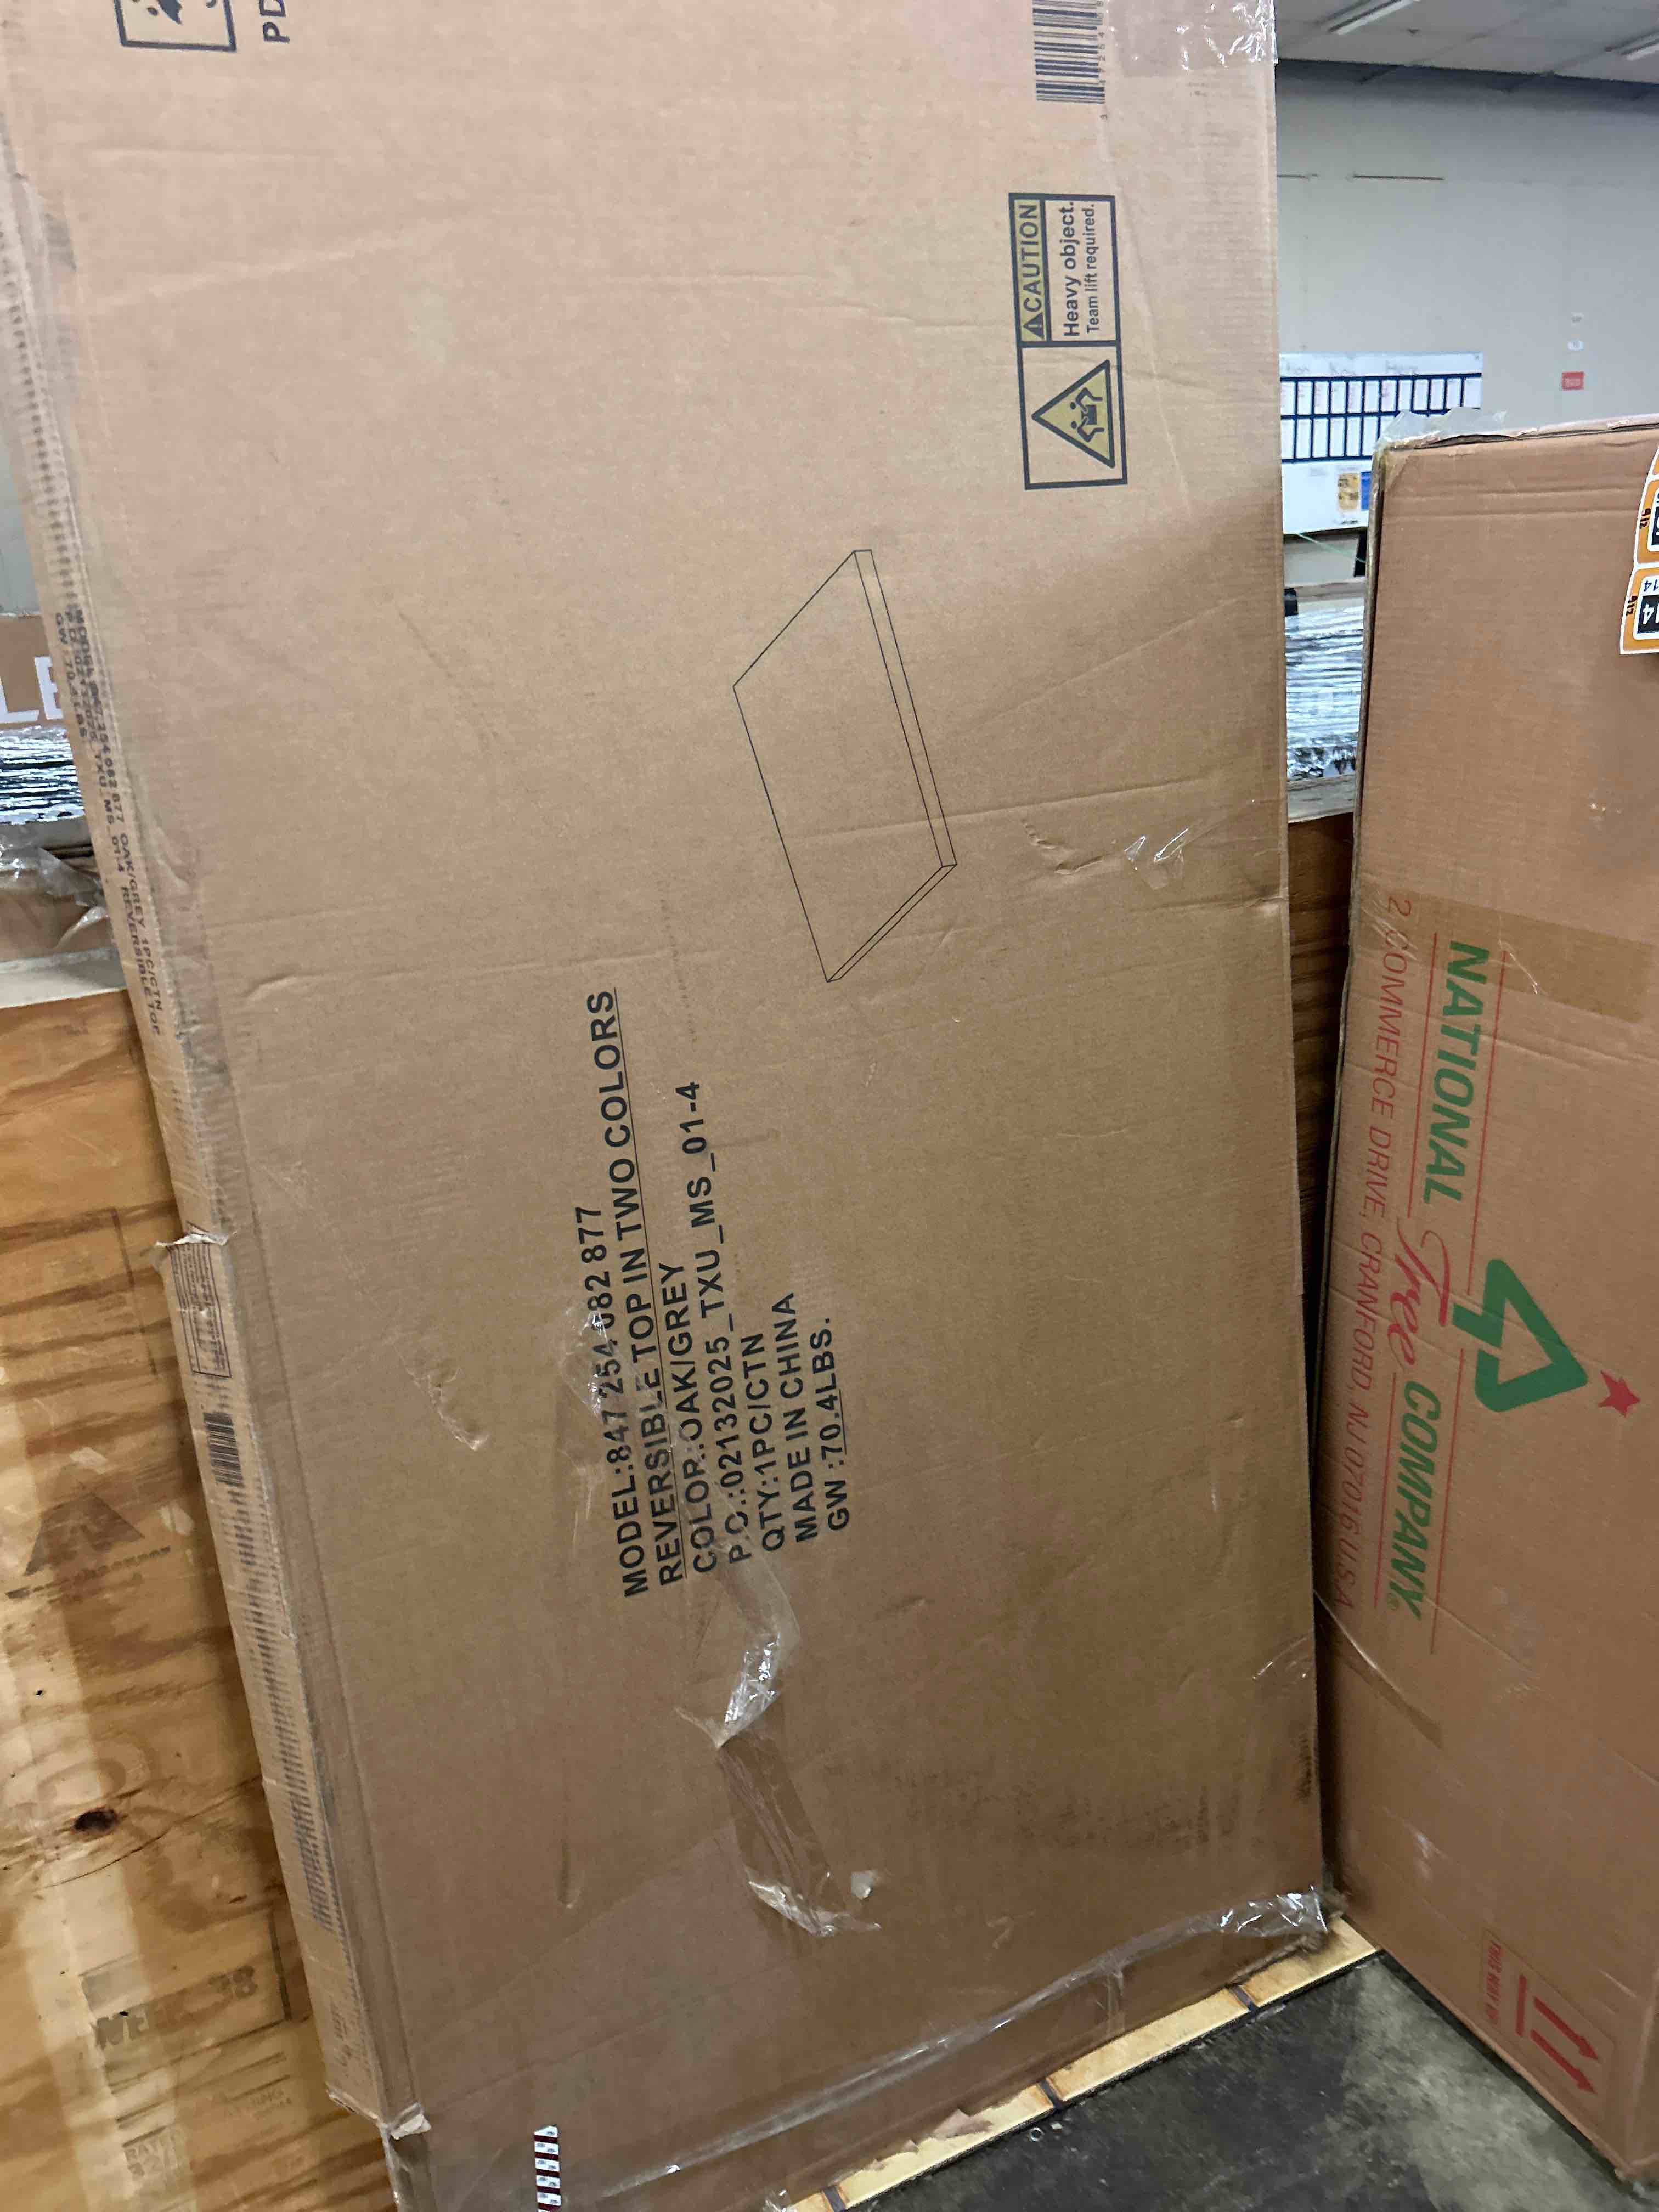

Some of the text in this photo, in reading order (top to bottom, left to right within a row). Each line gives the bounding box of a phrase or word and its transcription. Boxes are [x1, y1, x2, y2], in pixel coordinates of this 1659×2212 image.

[1018, 204, 1042, 312] CAUTION
[1058, 202, 1081, 336] Heavy object.
[1082, 204, 1099, 333] Team lift required.
[1387, 896, 1412, 918] 2
[1372, 930, 1409, 1119] COMMERCE
[575, 1207, 607, 1263] 877
[1359, 1126, 1392, 1218] DRIVE,
[586, 991, 683, 1586] REVERSIBLE TOP IN TWO COLORS
[1346, 1232, 1383, 1392] CRANFORD,
[1387, 940, 1490, 1621] NATIONAL Tree COMPANY
[594, 1340, 624, 1399] 254
[772, 1293, 819, 1543] MADE IN CHINA
[1346, 1403, 1368, 1446] NJ
[603, 1410, 650, 1598] MODEL:847
[1340, 1447, 1367, 1536] 07016
